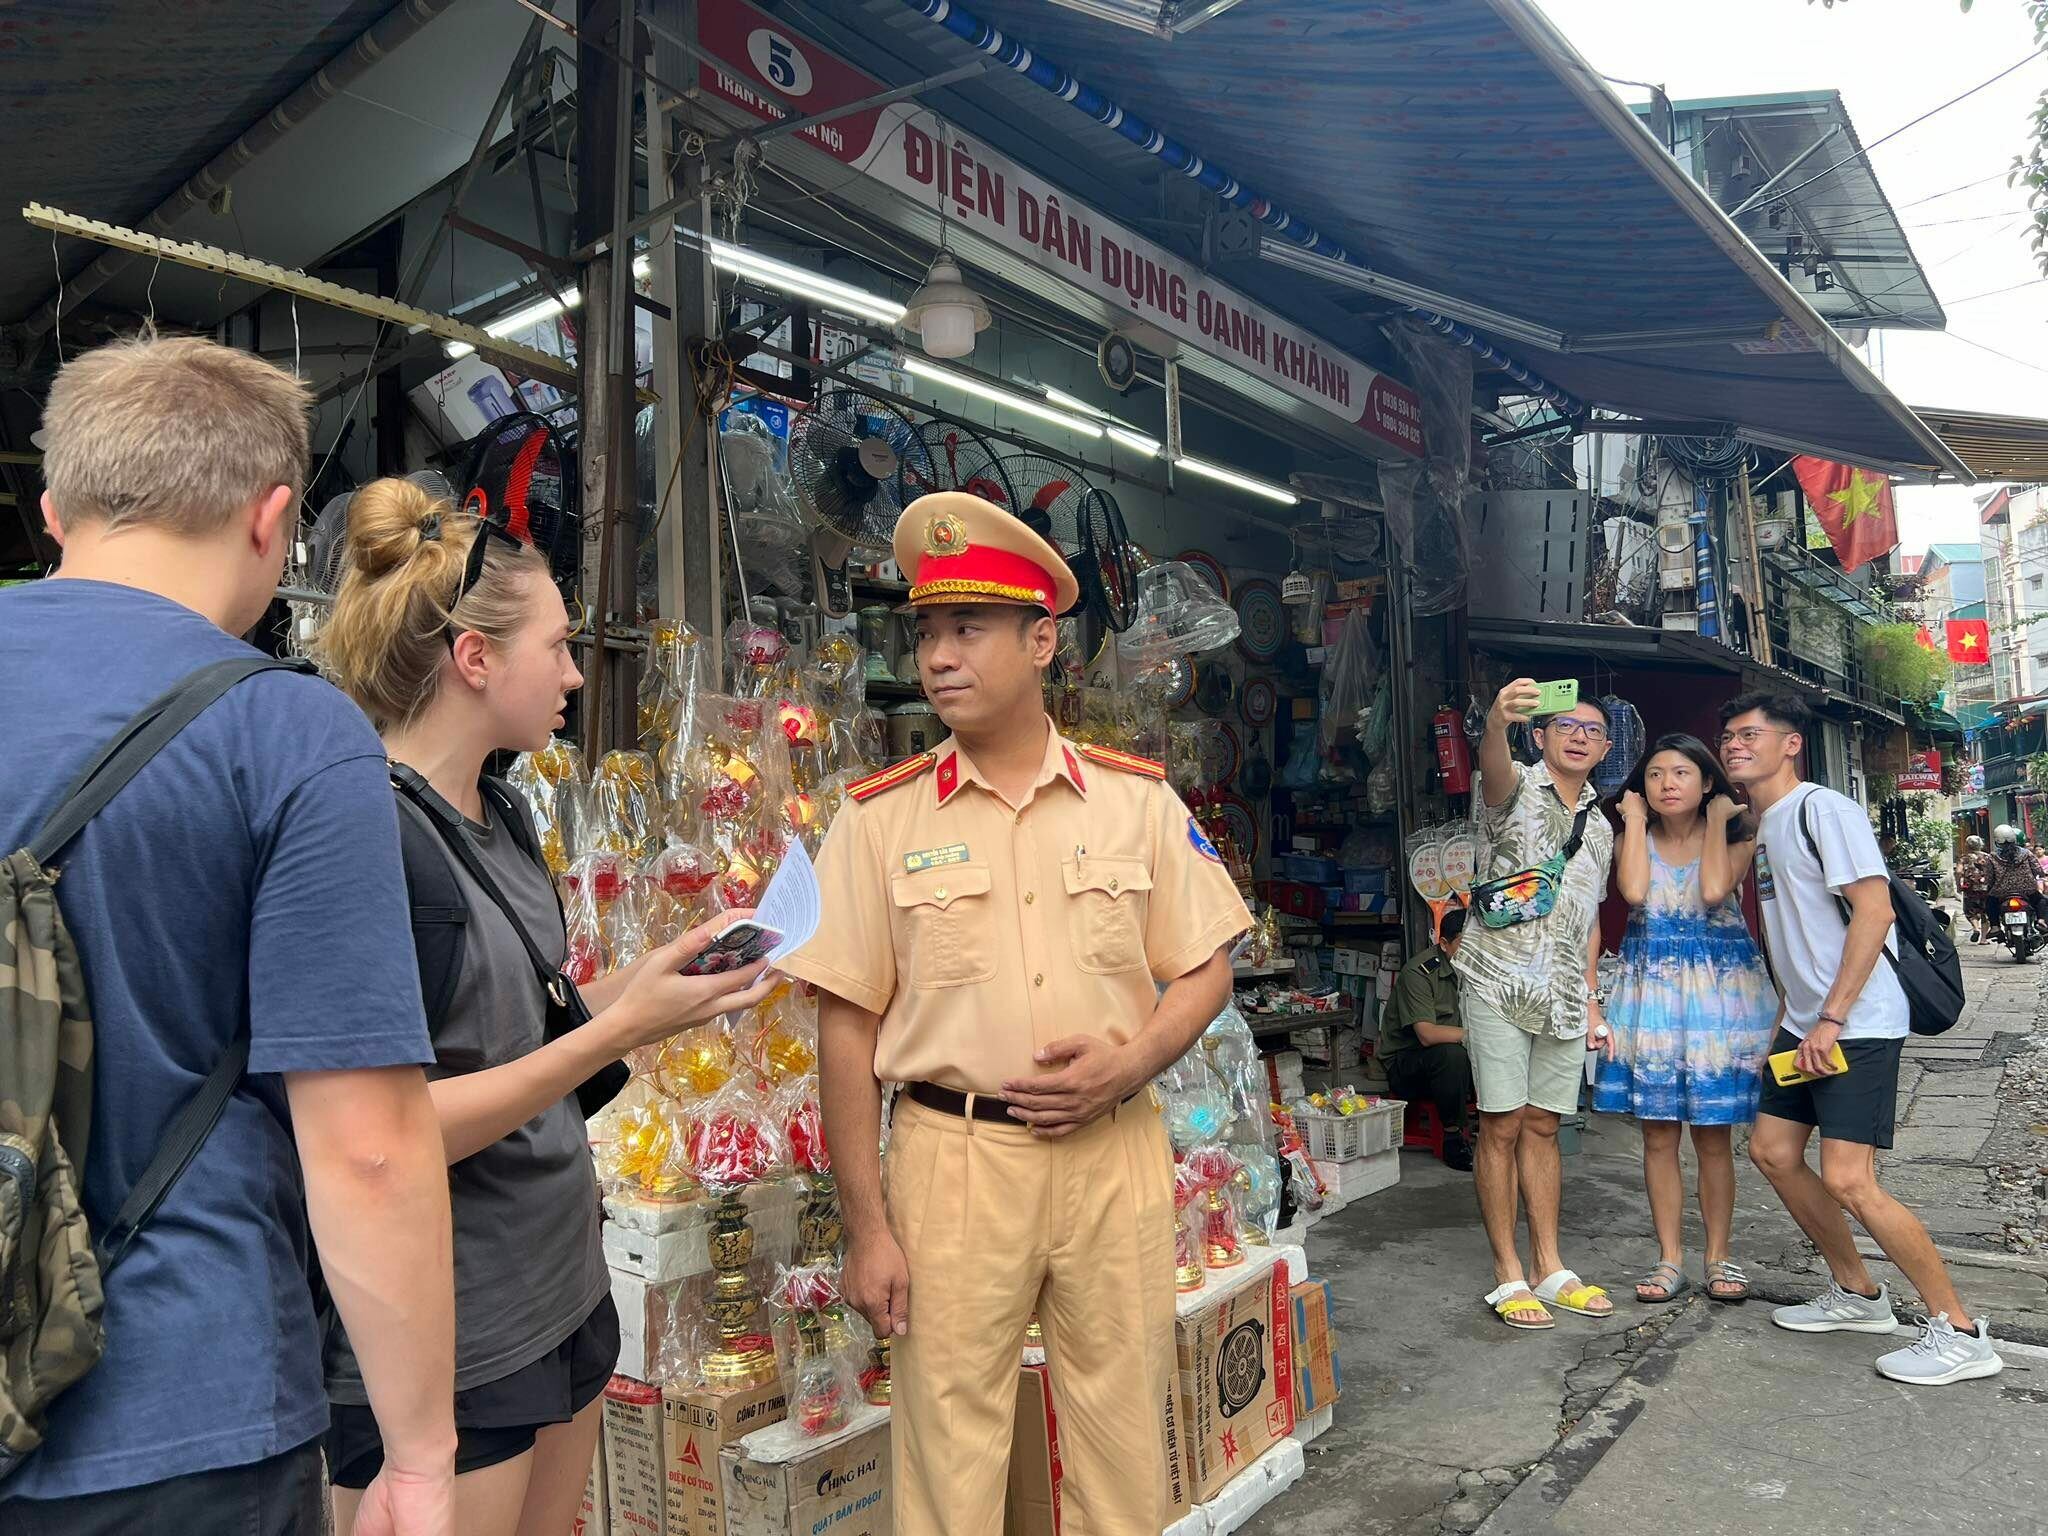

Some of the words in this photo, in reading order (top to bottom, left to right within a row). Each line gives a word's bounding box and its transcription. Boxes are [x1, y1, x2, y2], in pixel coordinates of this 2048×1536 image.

[768, 35, 796, 88] 5
[820, 124, 843, 152] NỘI
[904, 122, 1005, 228] ĐIỆN
[1017, 186, 1092, 274] DÂN
[1101, 236, 1188, 324] DỤNG
[1196, 288, 1266, 366] OANH
[1272, 340, 1350, 408] KHÁNH
[1898, 773, 1940, 782] RAILWAY
[736, 1405, 756, 1424] CÔNG
[757, 1402, 768, 1416] TY
[1165, 1415, 1176, 1428] CƠ
[1166, 1429, 1178, 1450] ĐIỆN
[1169, 1450, 1181, 1462] TỬ
[668, 1470, 687, 1485] ĐIỆN
[697, 1478, 714, 1492] TICO
[1170, 1462, 1181, 1481] VIỆT
[817, 1469, 855, 1497] CHING
[1171, 1481, 1184, 1505] NHẬT
[855, 1489, 882, 1514] HD601
[622, 1510, 638, 1523] TICO
